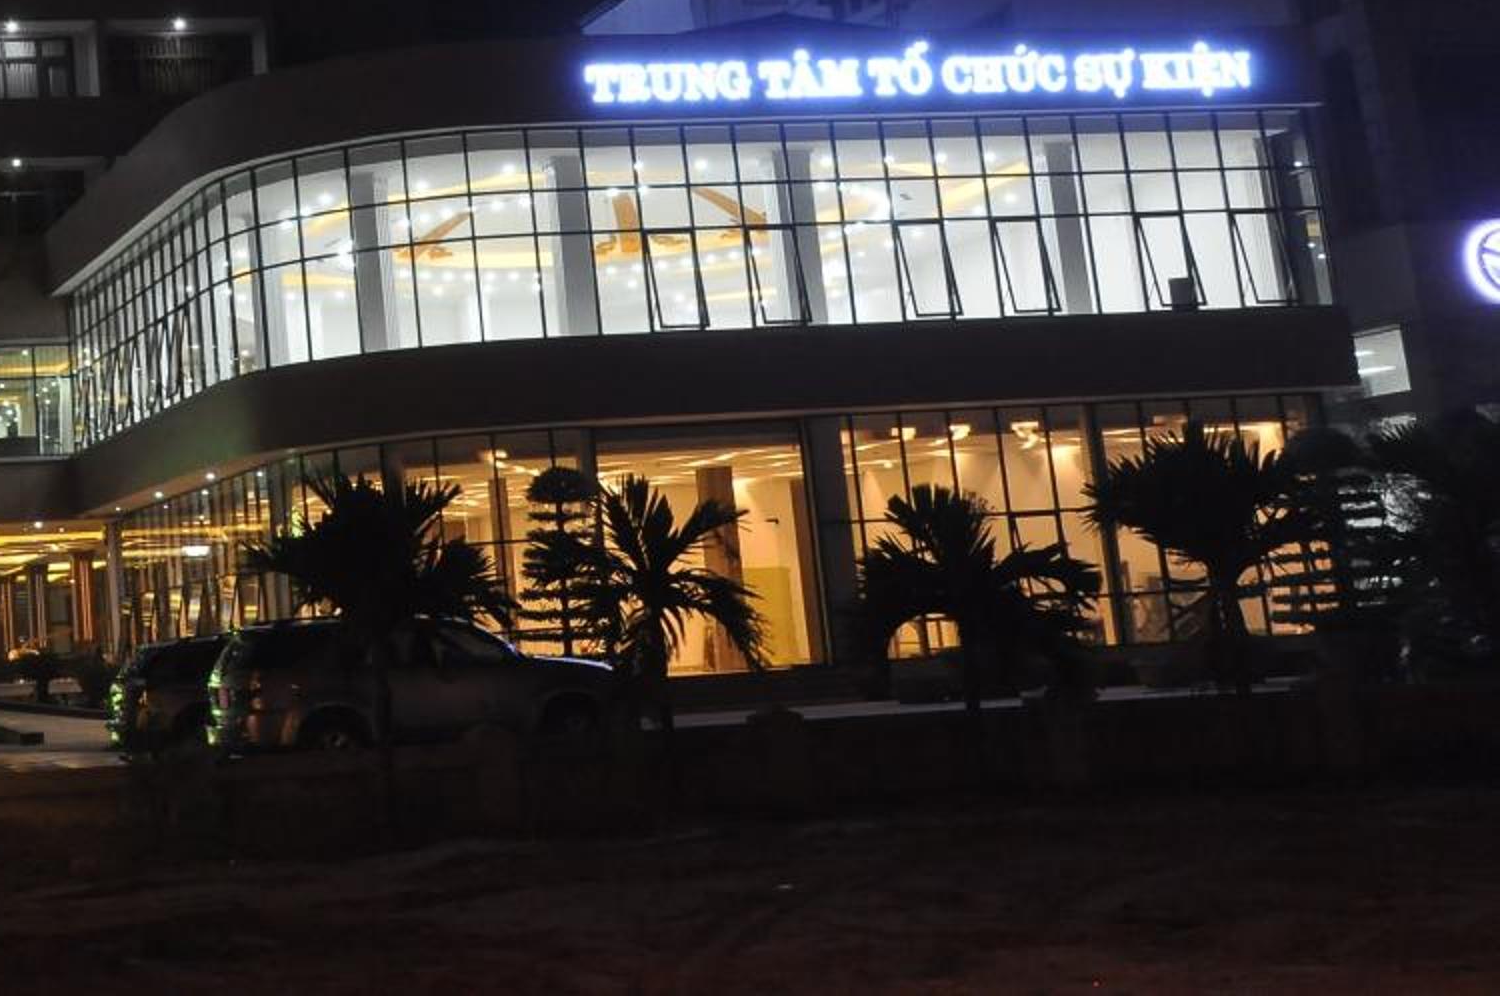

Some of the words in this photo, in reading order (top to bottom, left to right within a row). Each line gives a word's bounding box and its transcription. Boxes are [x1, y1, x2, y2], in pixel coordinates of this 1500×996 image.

[585, 60, 752, 103] TRUNG
[758, 49, 863, 99] TÂM
[941, 44, 1067, 95] CHỨC
[1073, 48, 1135, 99] SỰ
[1140, 41, 1251, 97] KIỆN
